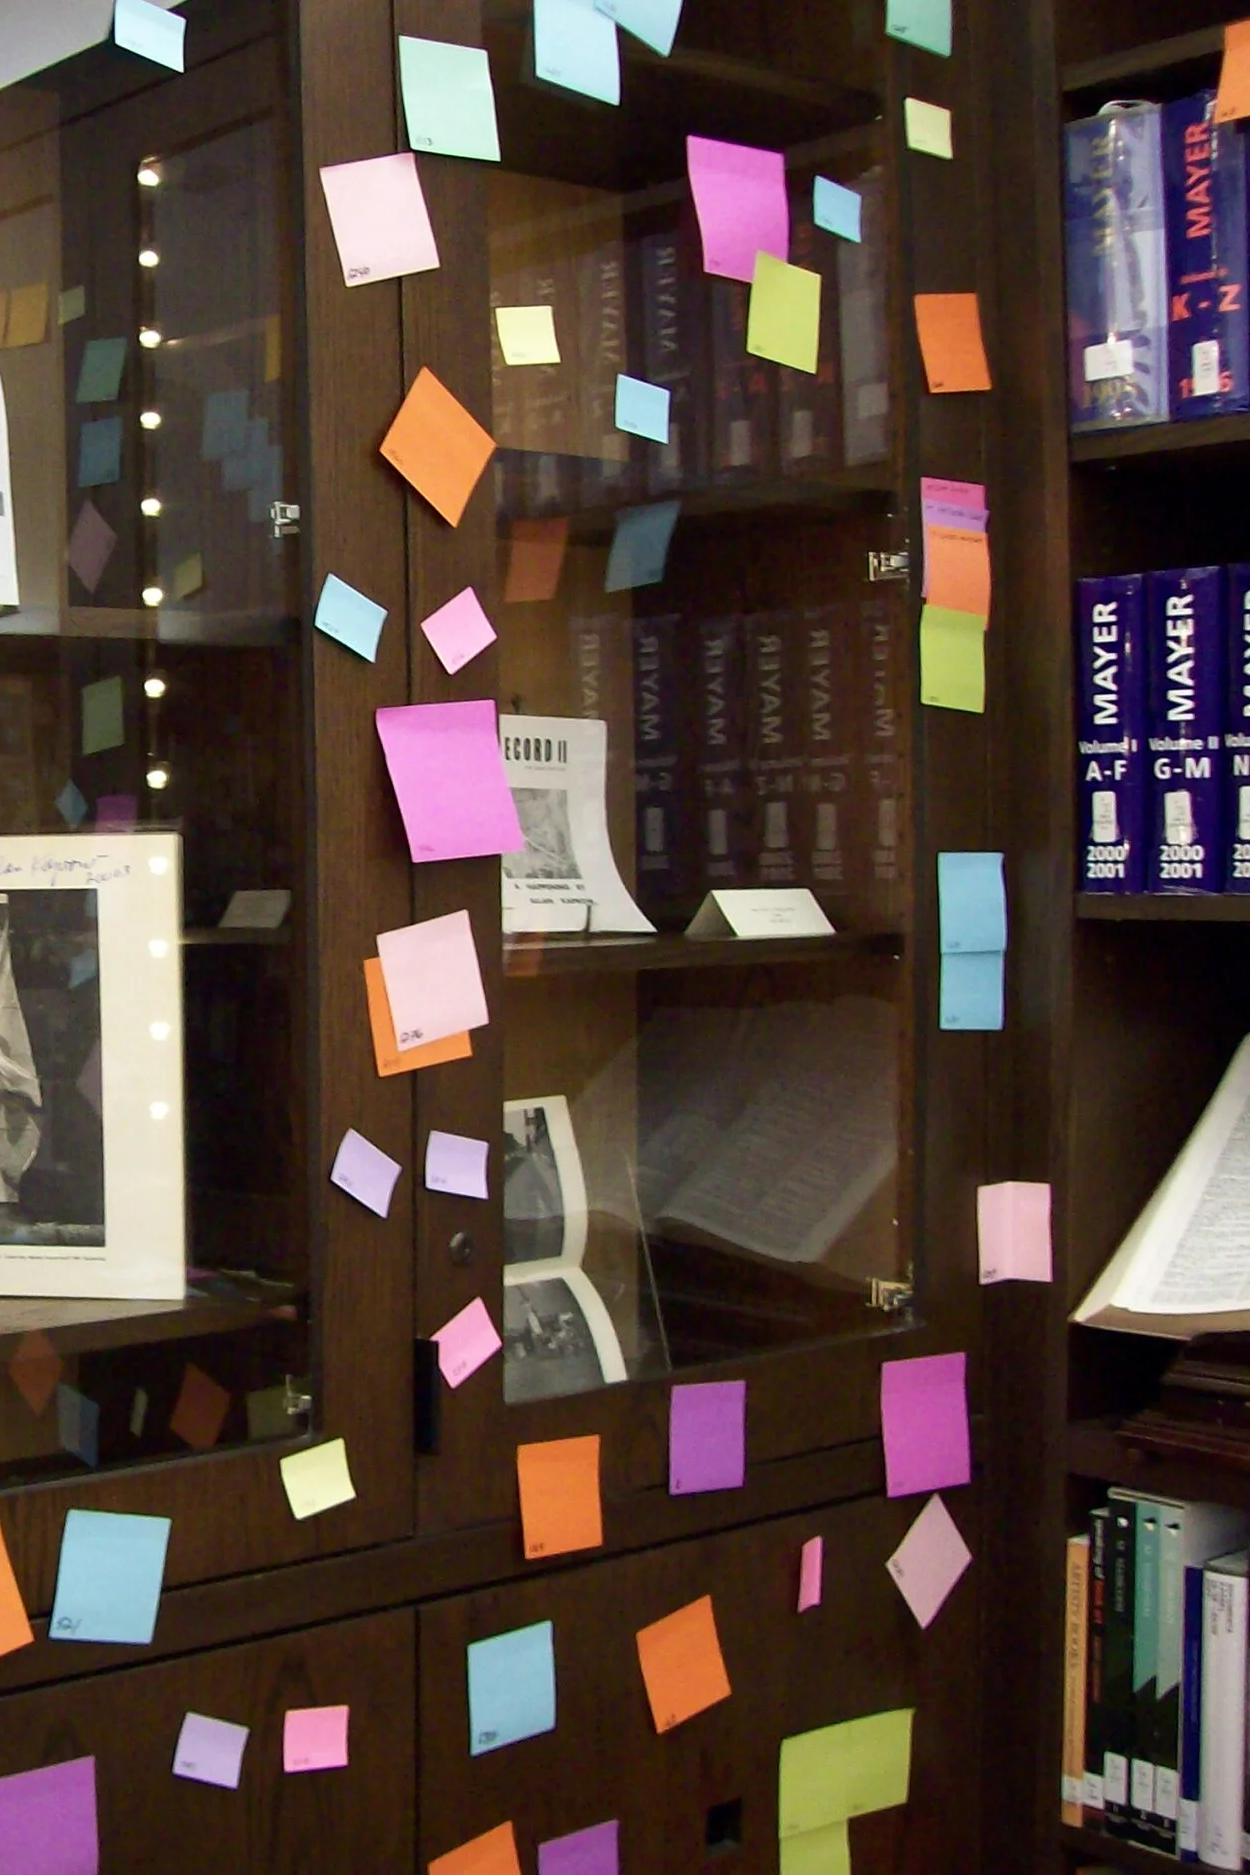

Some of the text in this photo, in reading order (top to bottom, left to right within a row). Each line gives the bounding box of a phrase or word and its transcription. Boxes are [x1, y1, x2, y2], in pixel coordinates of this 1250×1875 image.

[1185, 122, 1213, 240] MAYER
[1093, 600, 1118, 726] MAYER
[1166, 593, 1195, 721] MAYER
[504, 737, 551, 762] ECORD
[1079, 738, 1128, 754] Volume
[1149, 737, 1204, 751] Volume
[1085, 759, 1128, 781] A-F
[1154, 757, 1211, 780] G-M
[1086, 845, 1127, 861] 2000
[1159, 845, 1205, 861] 2000
[1086, 862, 1125, 878] 2001
[1159, 862, 1203, 878] 2001
